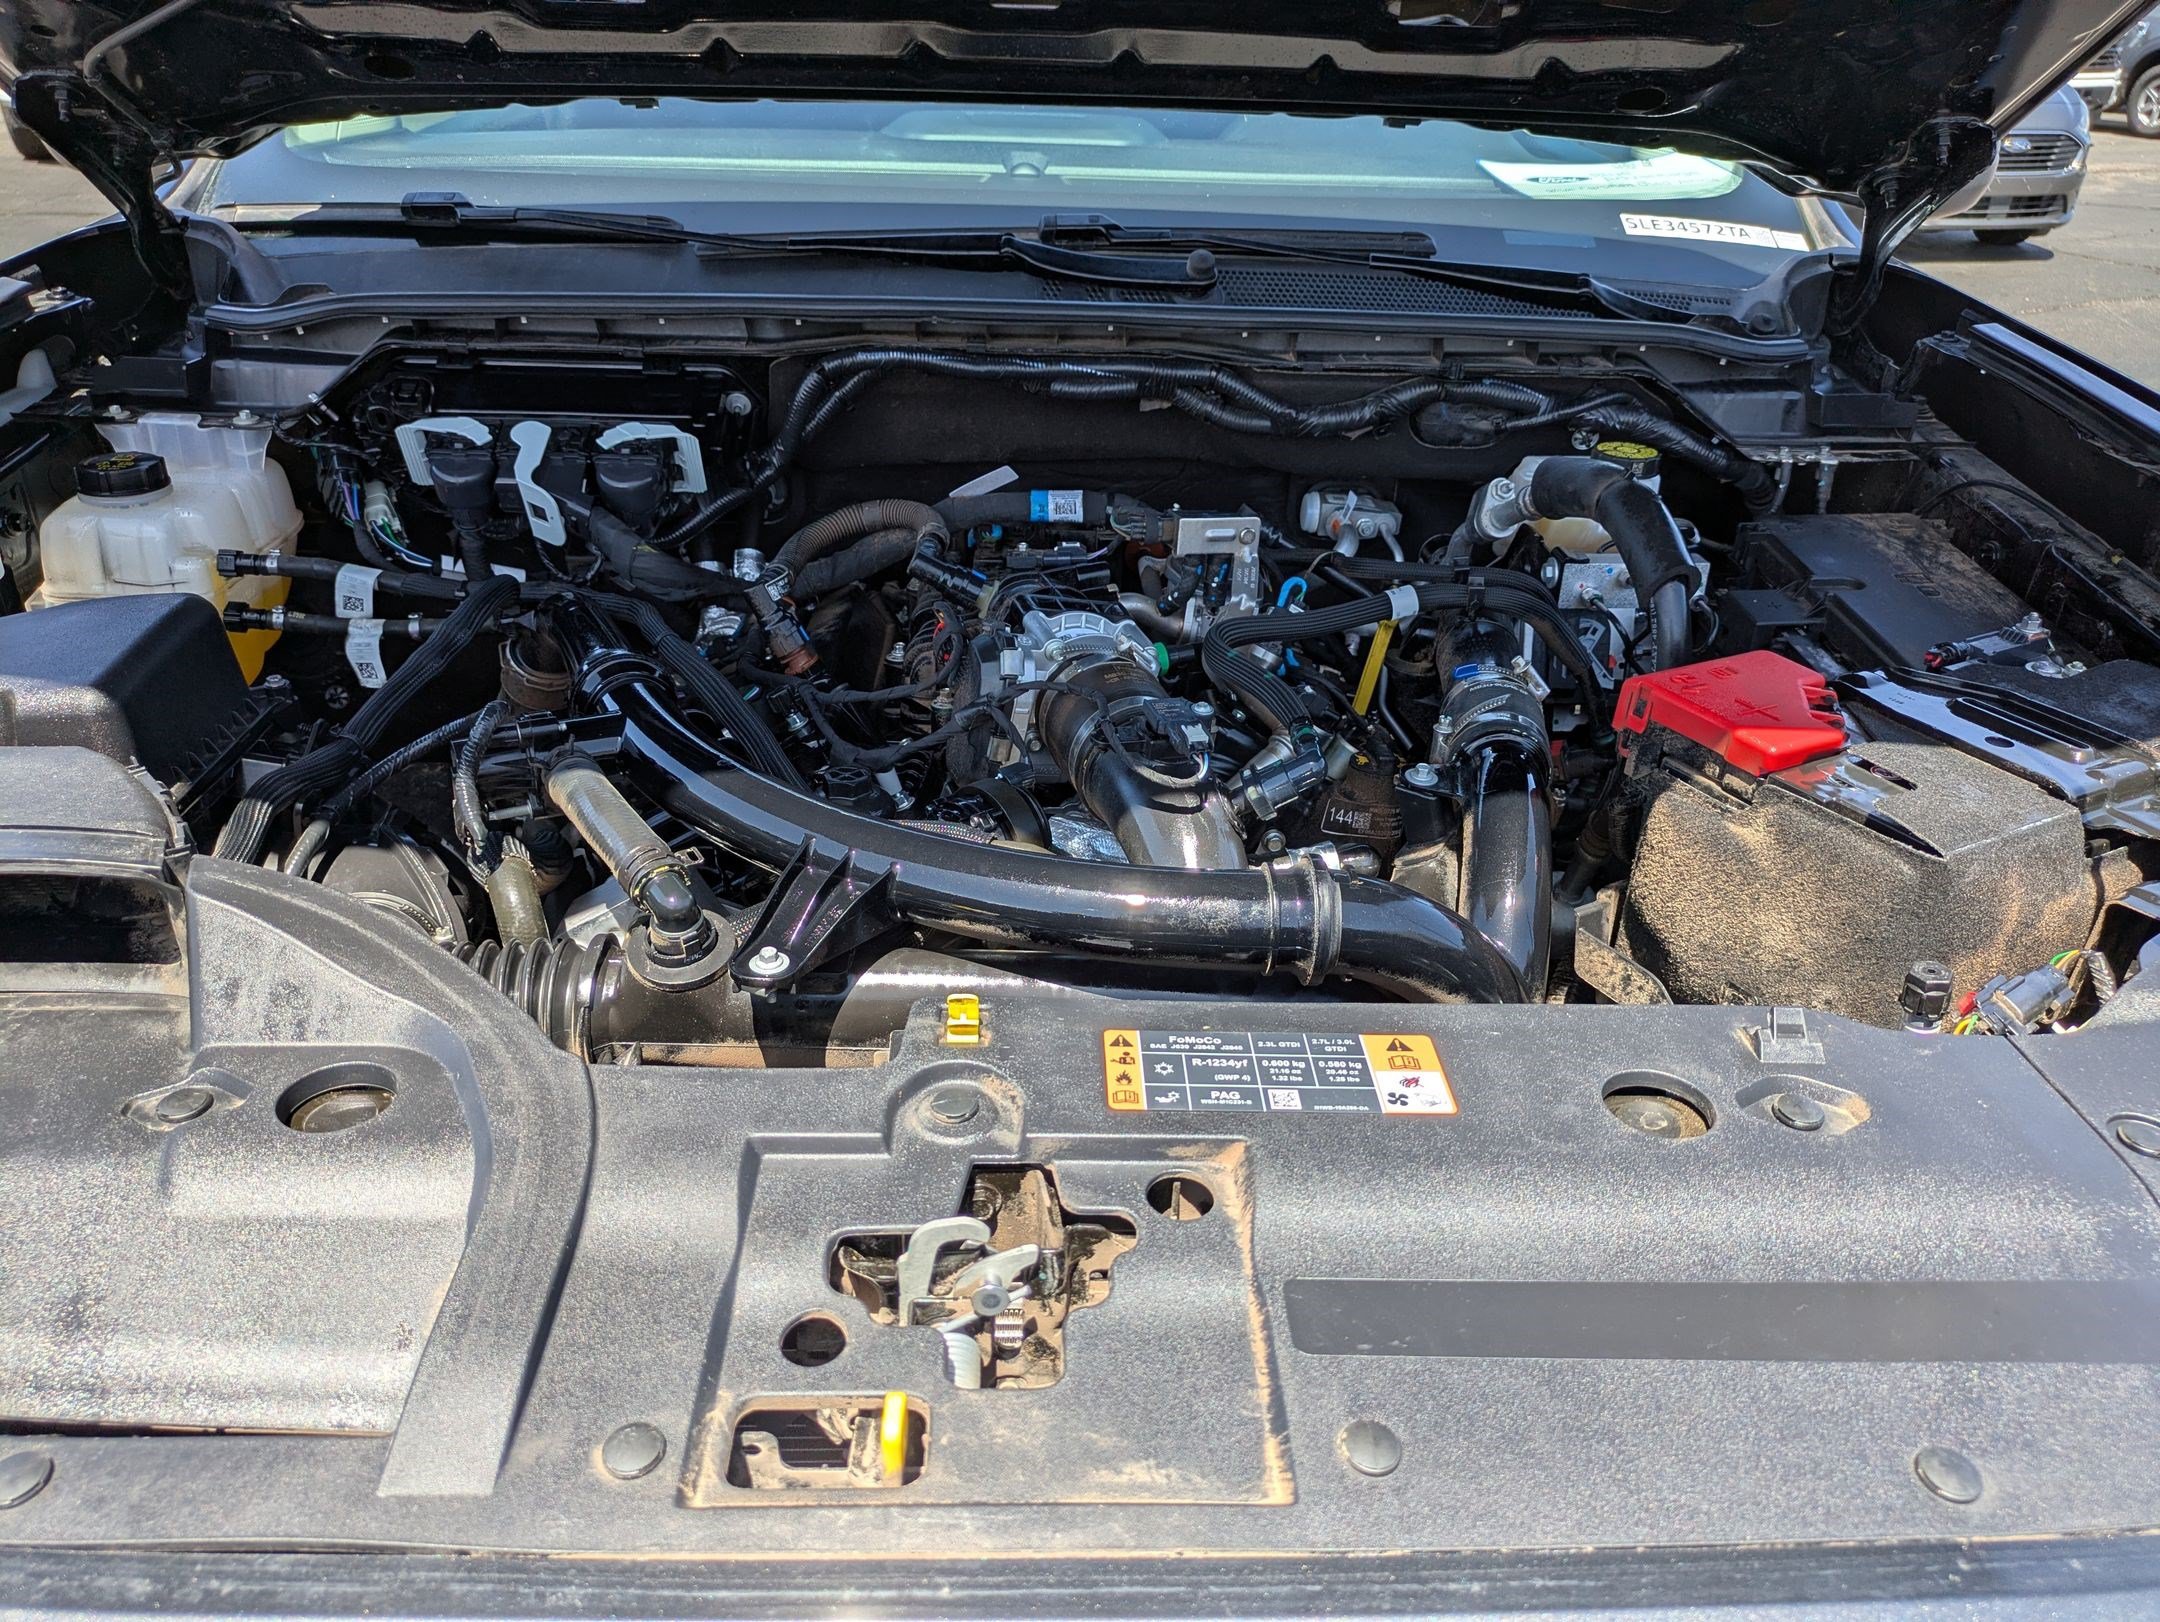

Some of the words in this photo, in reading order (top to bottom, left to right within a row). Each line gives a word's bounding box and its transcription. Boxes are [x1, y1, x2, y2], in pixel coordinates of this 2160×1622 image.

[1625, 217, 1752, 239] SLE34572TA
[1330, 806, 1353, 825] 144
[1168, 1035, 1222, 1044] FoMoCo
[1191, 1058, 1248, 1069] R-1234yf
[1291, 1060, 1306, 1069] kg
[1348, 1061, 1363, 1069] kg
[1241, 1074, 1251, 1082] 4)
[1210, 1090, 1241, 1100] PAG
